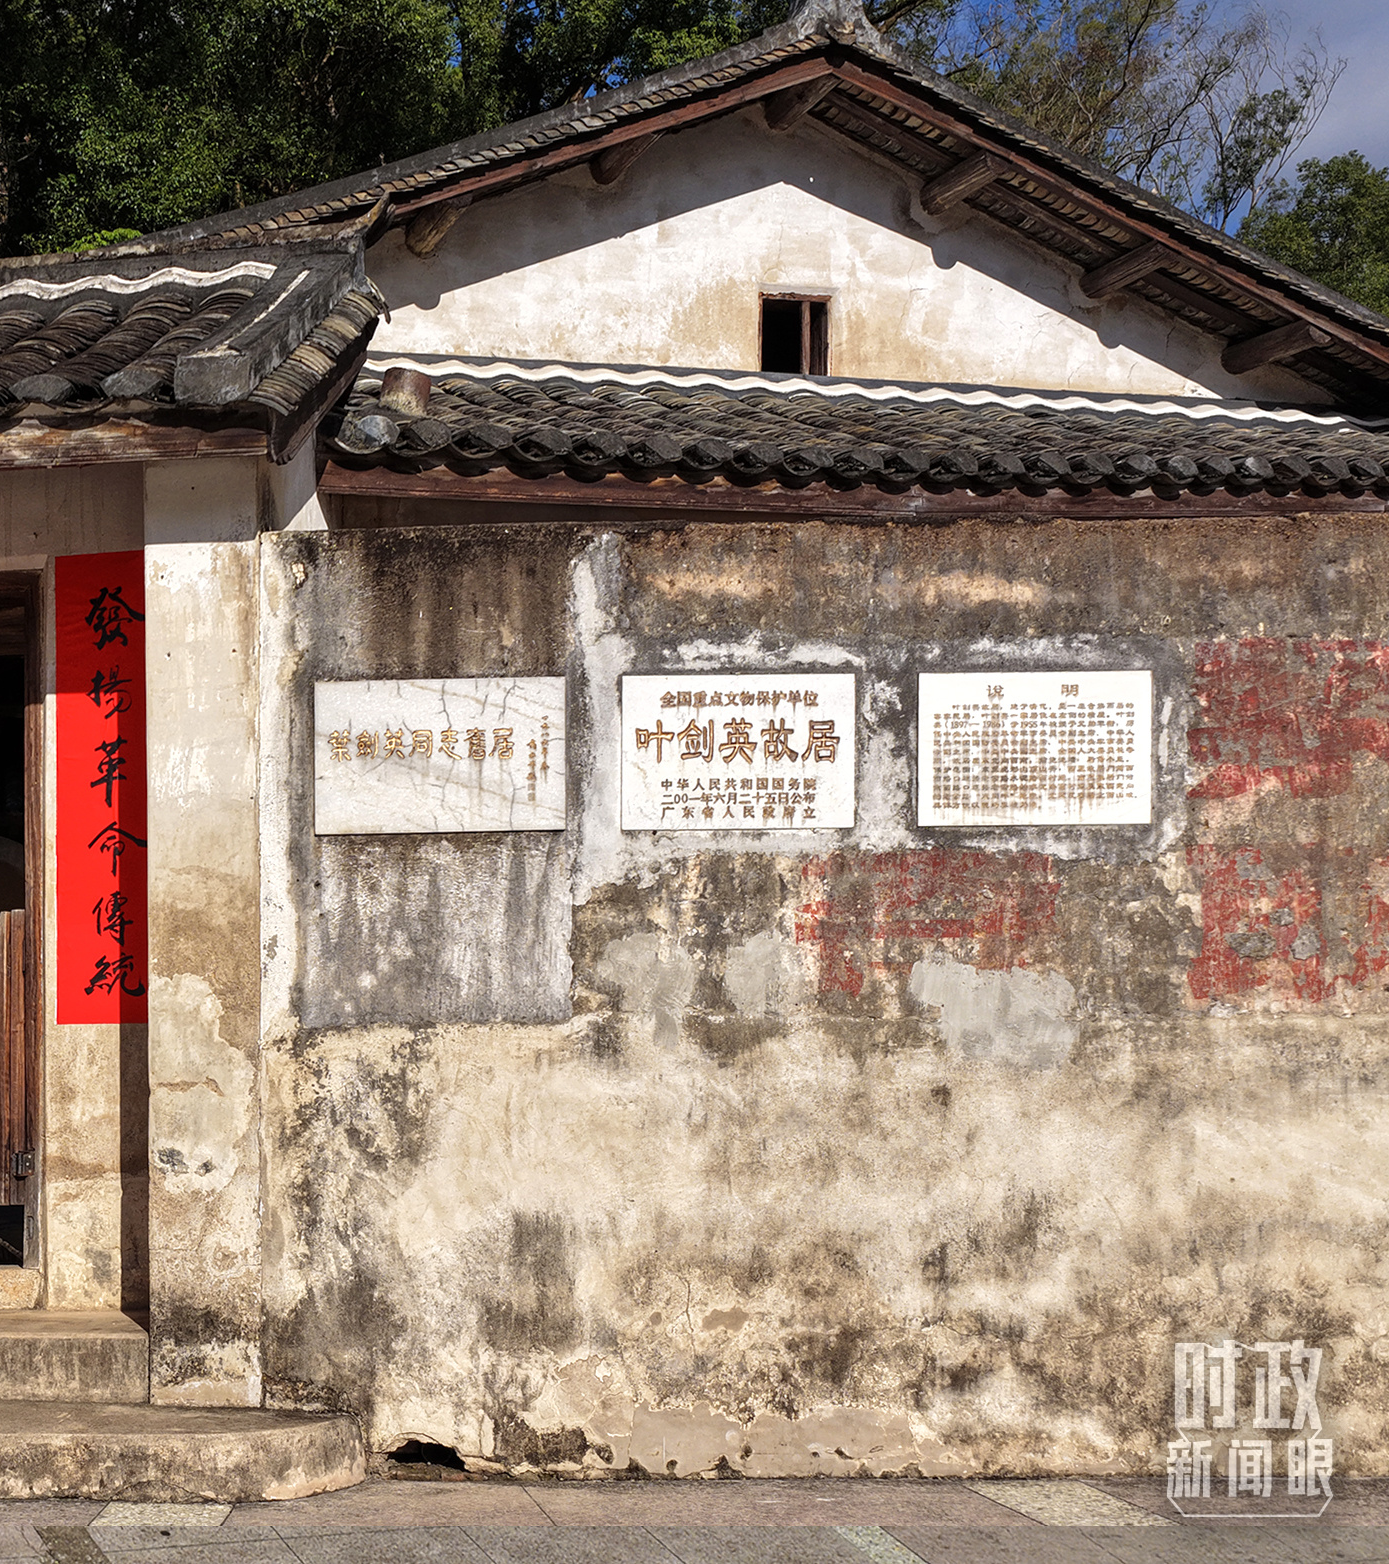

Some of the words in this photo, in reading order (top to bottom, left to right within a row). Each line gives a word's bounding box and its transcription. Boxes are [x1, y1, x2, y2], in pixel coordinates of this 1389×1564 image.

[659, 690, 819, 709] 全国重点文物保护单位
[635, 717, 840, 764] 叶剑英故居
[84, 586, 148, 998] 發揚革命傳統
[660, 778, 817, 791] 中华人民共和国国务院
[660, 806, 817, 820] 广东省人民政府立
